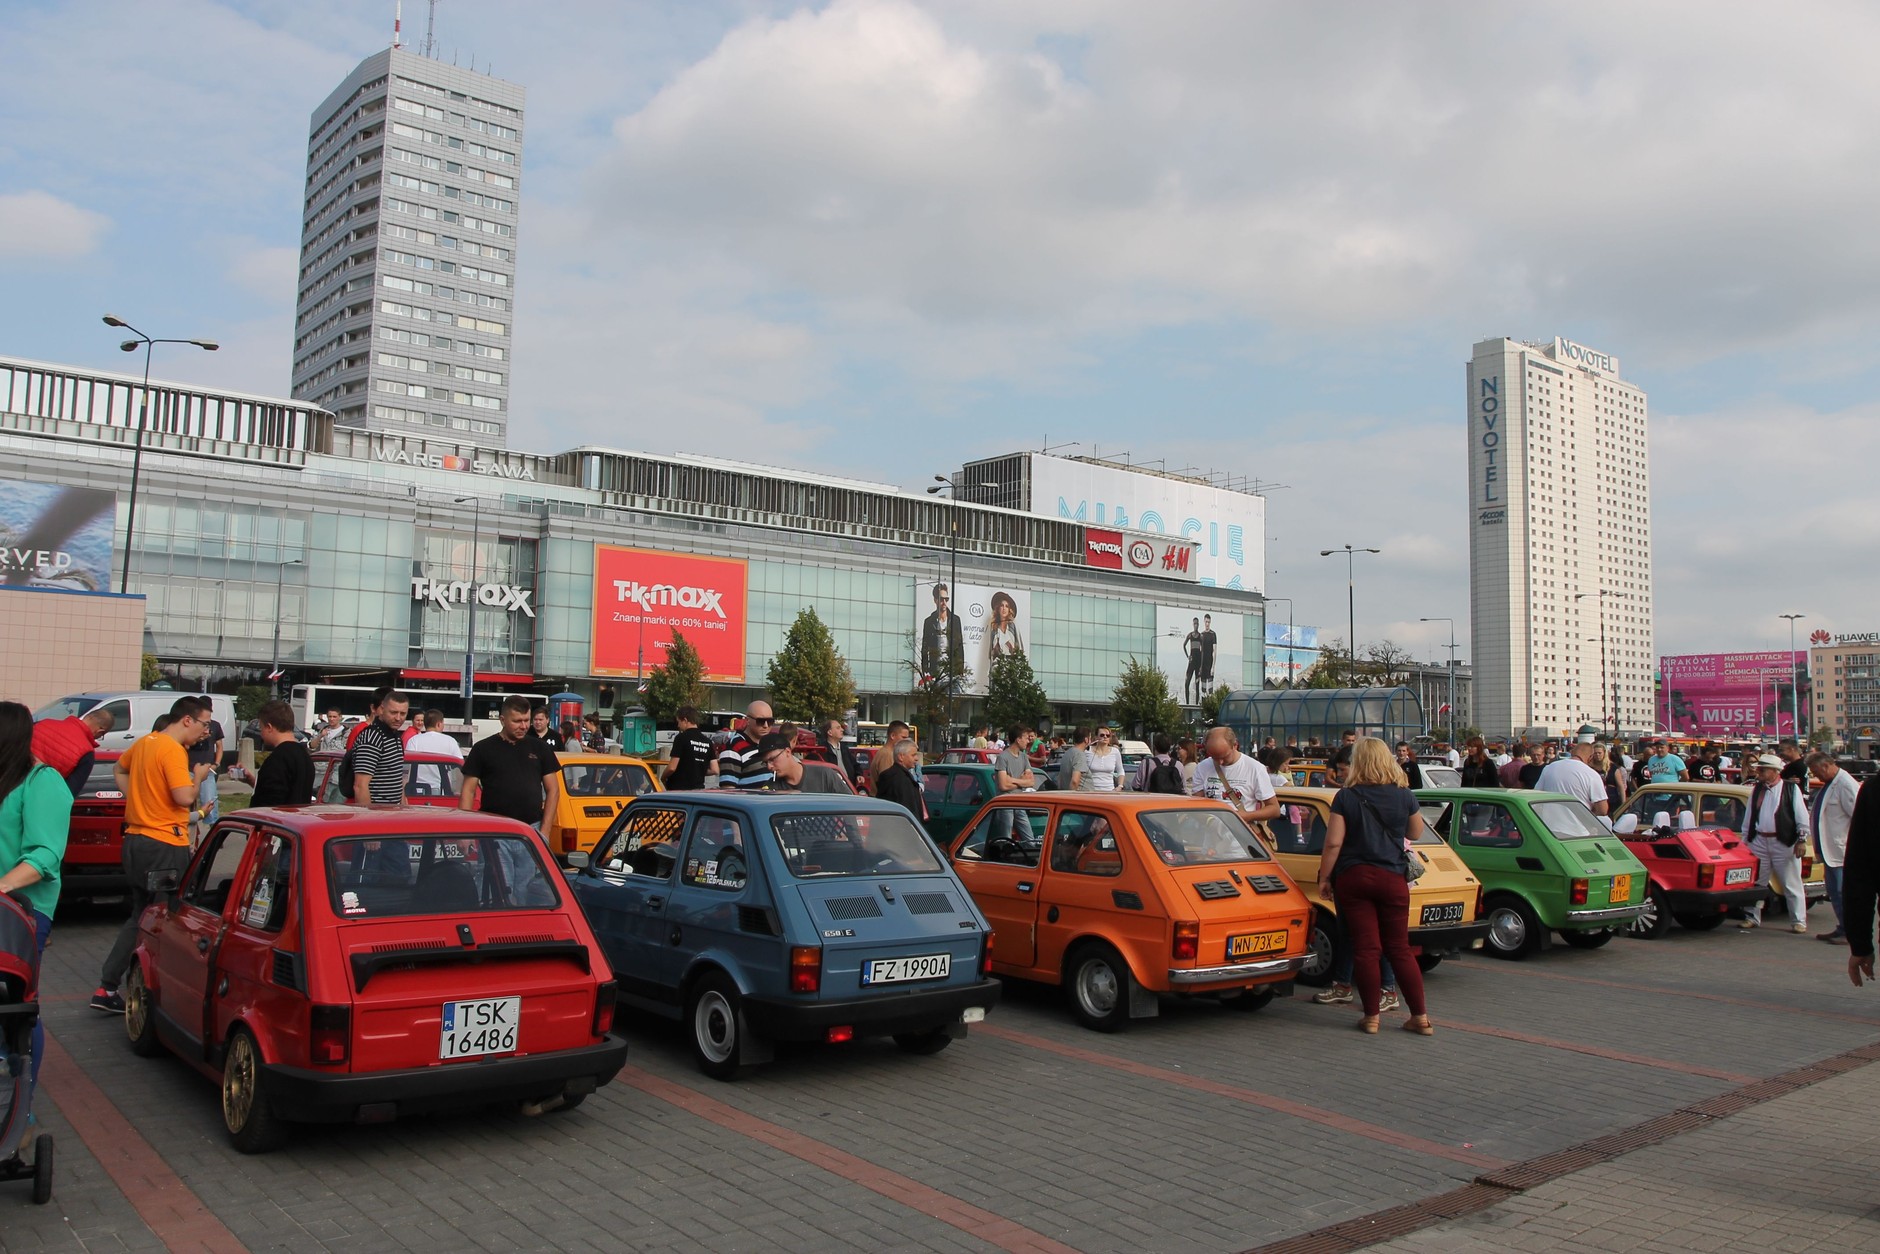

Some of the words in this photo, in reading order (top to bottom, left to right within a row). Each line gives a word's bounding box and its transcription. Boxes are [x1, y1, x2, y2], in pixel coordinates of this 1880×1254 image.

[1560, 337, 1616, 374] NOVOTEL
[1481, 376, 1499, 502] NOVOTEL
[374, 446, 443, 468] WARS
[473, 460, 536, 481] SAWA
[1161, 544, 1191, 574] H&M
[613, 612, 641, 623] Znane
[643, 616, 667, 626] marki
[669, 617, 680, 627] do
[682, 618, 702, 628] 60%
[1834, 632, 1879, 642] HUAWEI
[1663, 655, 1710, 666] KRAKÓW
[1759, 653, 1783, 661] ATTACK
[1663, 665, 1710, 673] FESTIVAL
[1703, 708, 1756, 722] MUSE
[1423, 907, 1442, 921] PZD
[1444, 905, 1463, 919] 3530
[1234, 937, 1251, 953] WN
[1253, 934, 1273, 951] 73X
[872, 961, 897, 981] FZ
[903, 956, 947, 978] 1990A
[460, 1001, 508, 1027] TSK
[445, 1020, 453, 1028] PL
[448, 1026, 515, 1055] 16486
